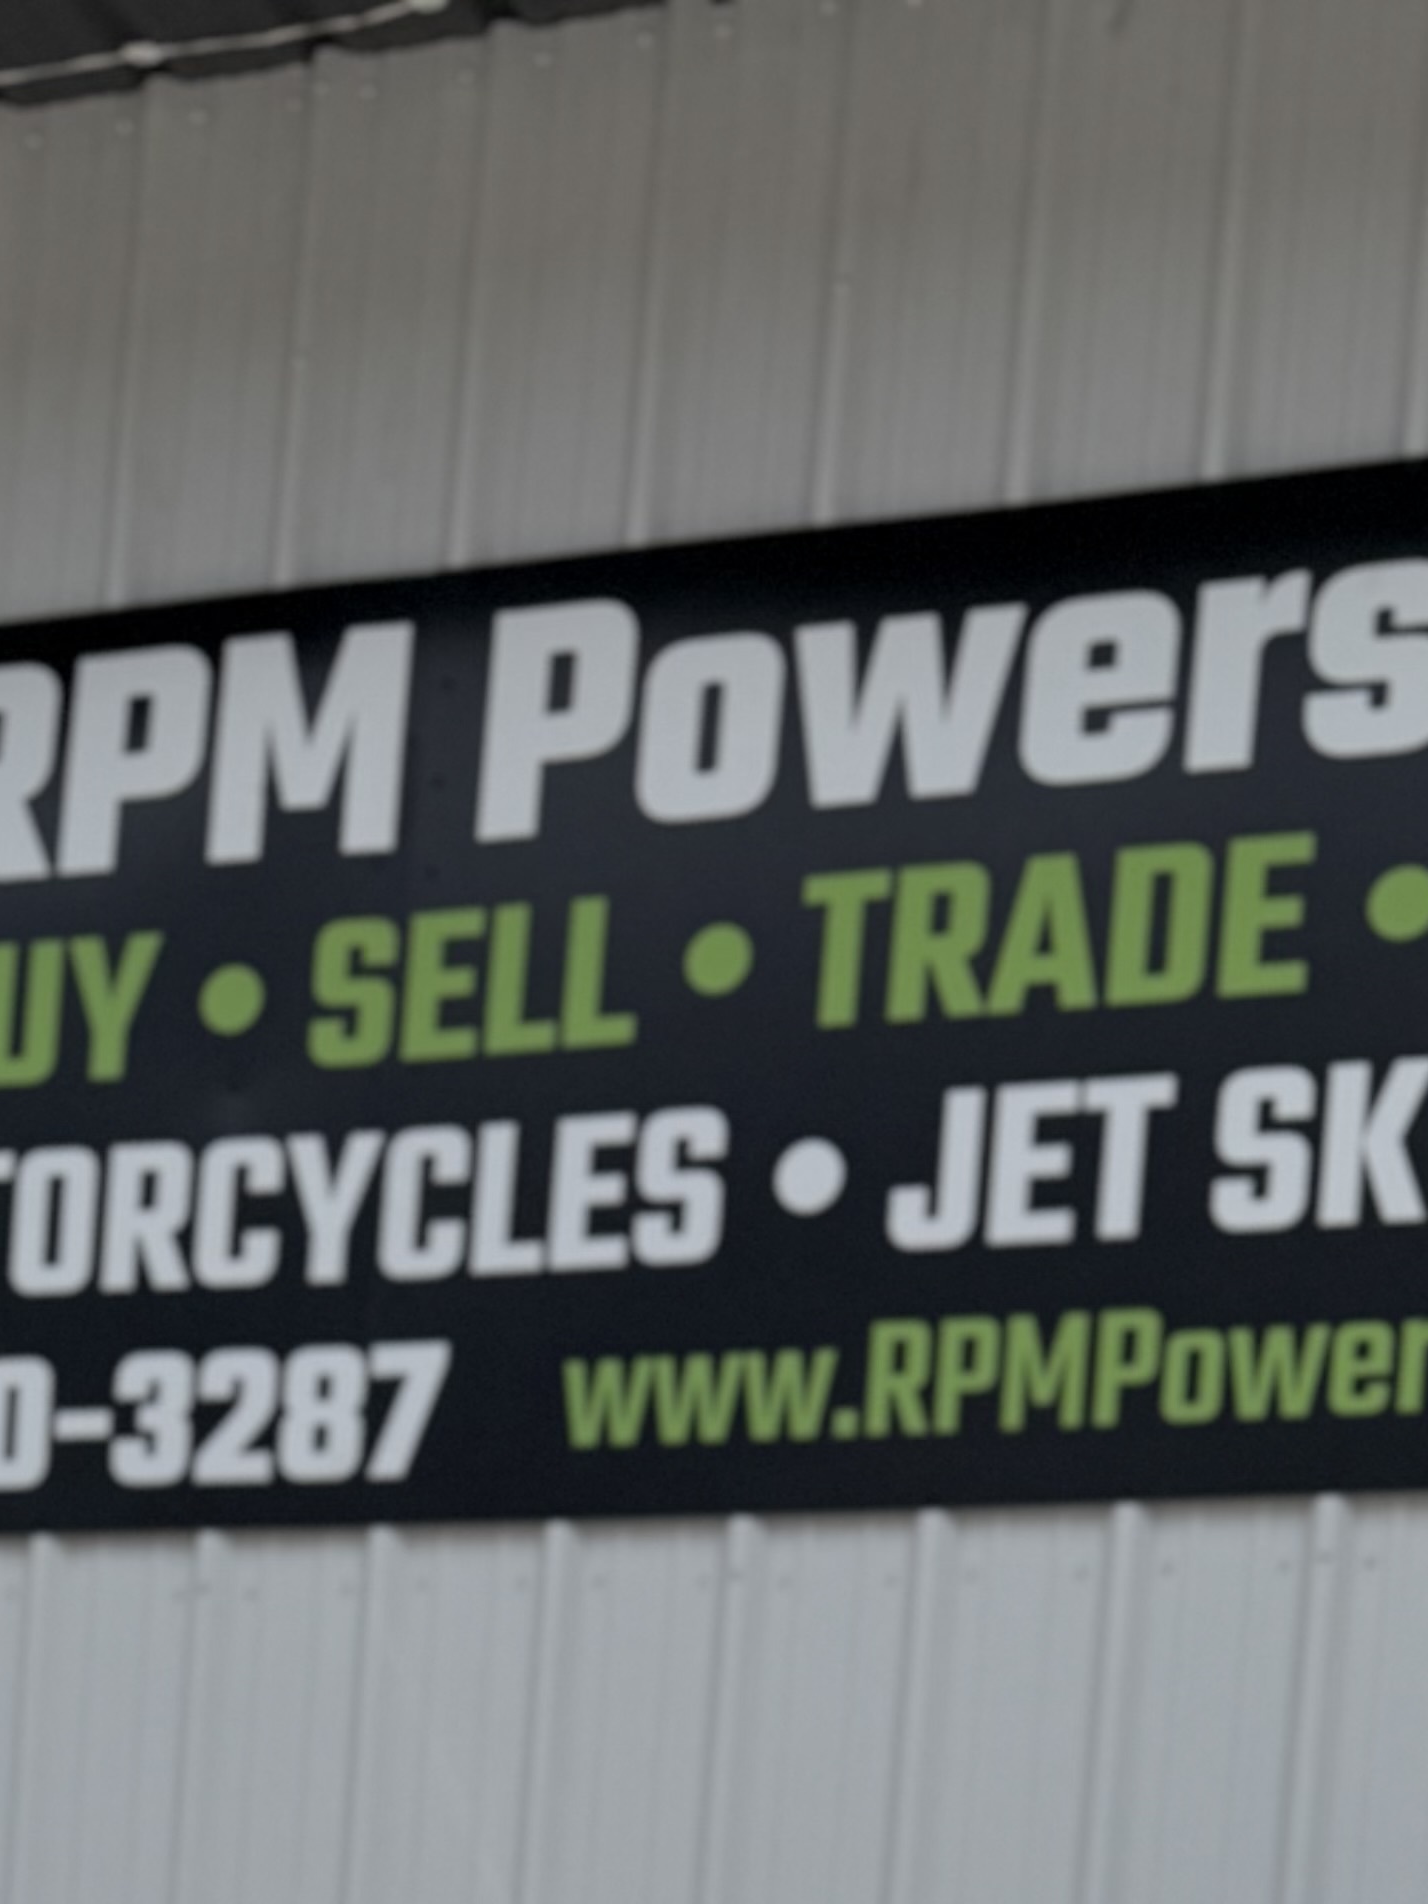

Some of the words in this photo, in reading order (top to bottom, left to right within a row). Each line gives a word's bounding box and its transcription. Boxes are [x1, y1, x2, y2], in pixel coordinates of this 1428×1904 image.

[305, 894, 639, 1069] SELL
[801, 830, 1318, 1030] TRADE
[883, 1072, 1178, 1254] JET
